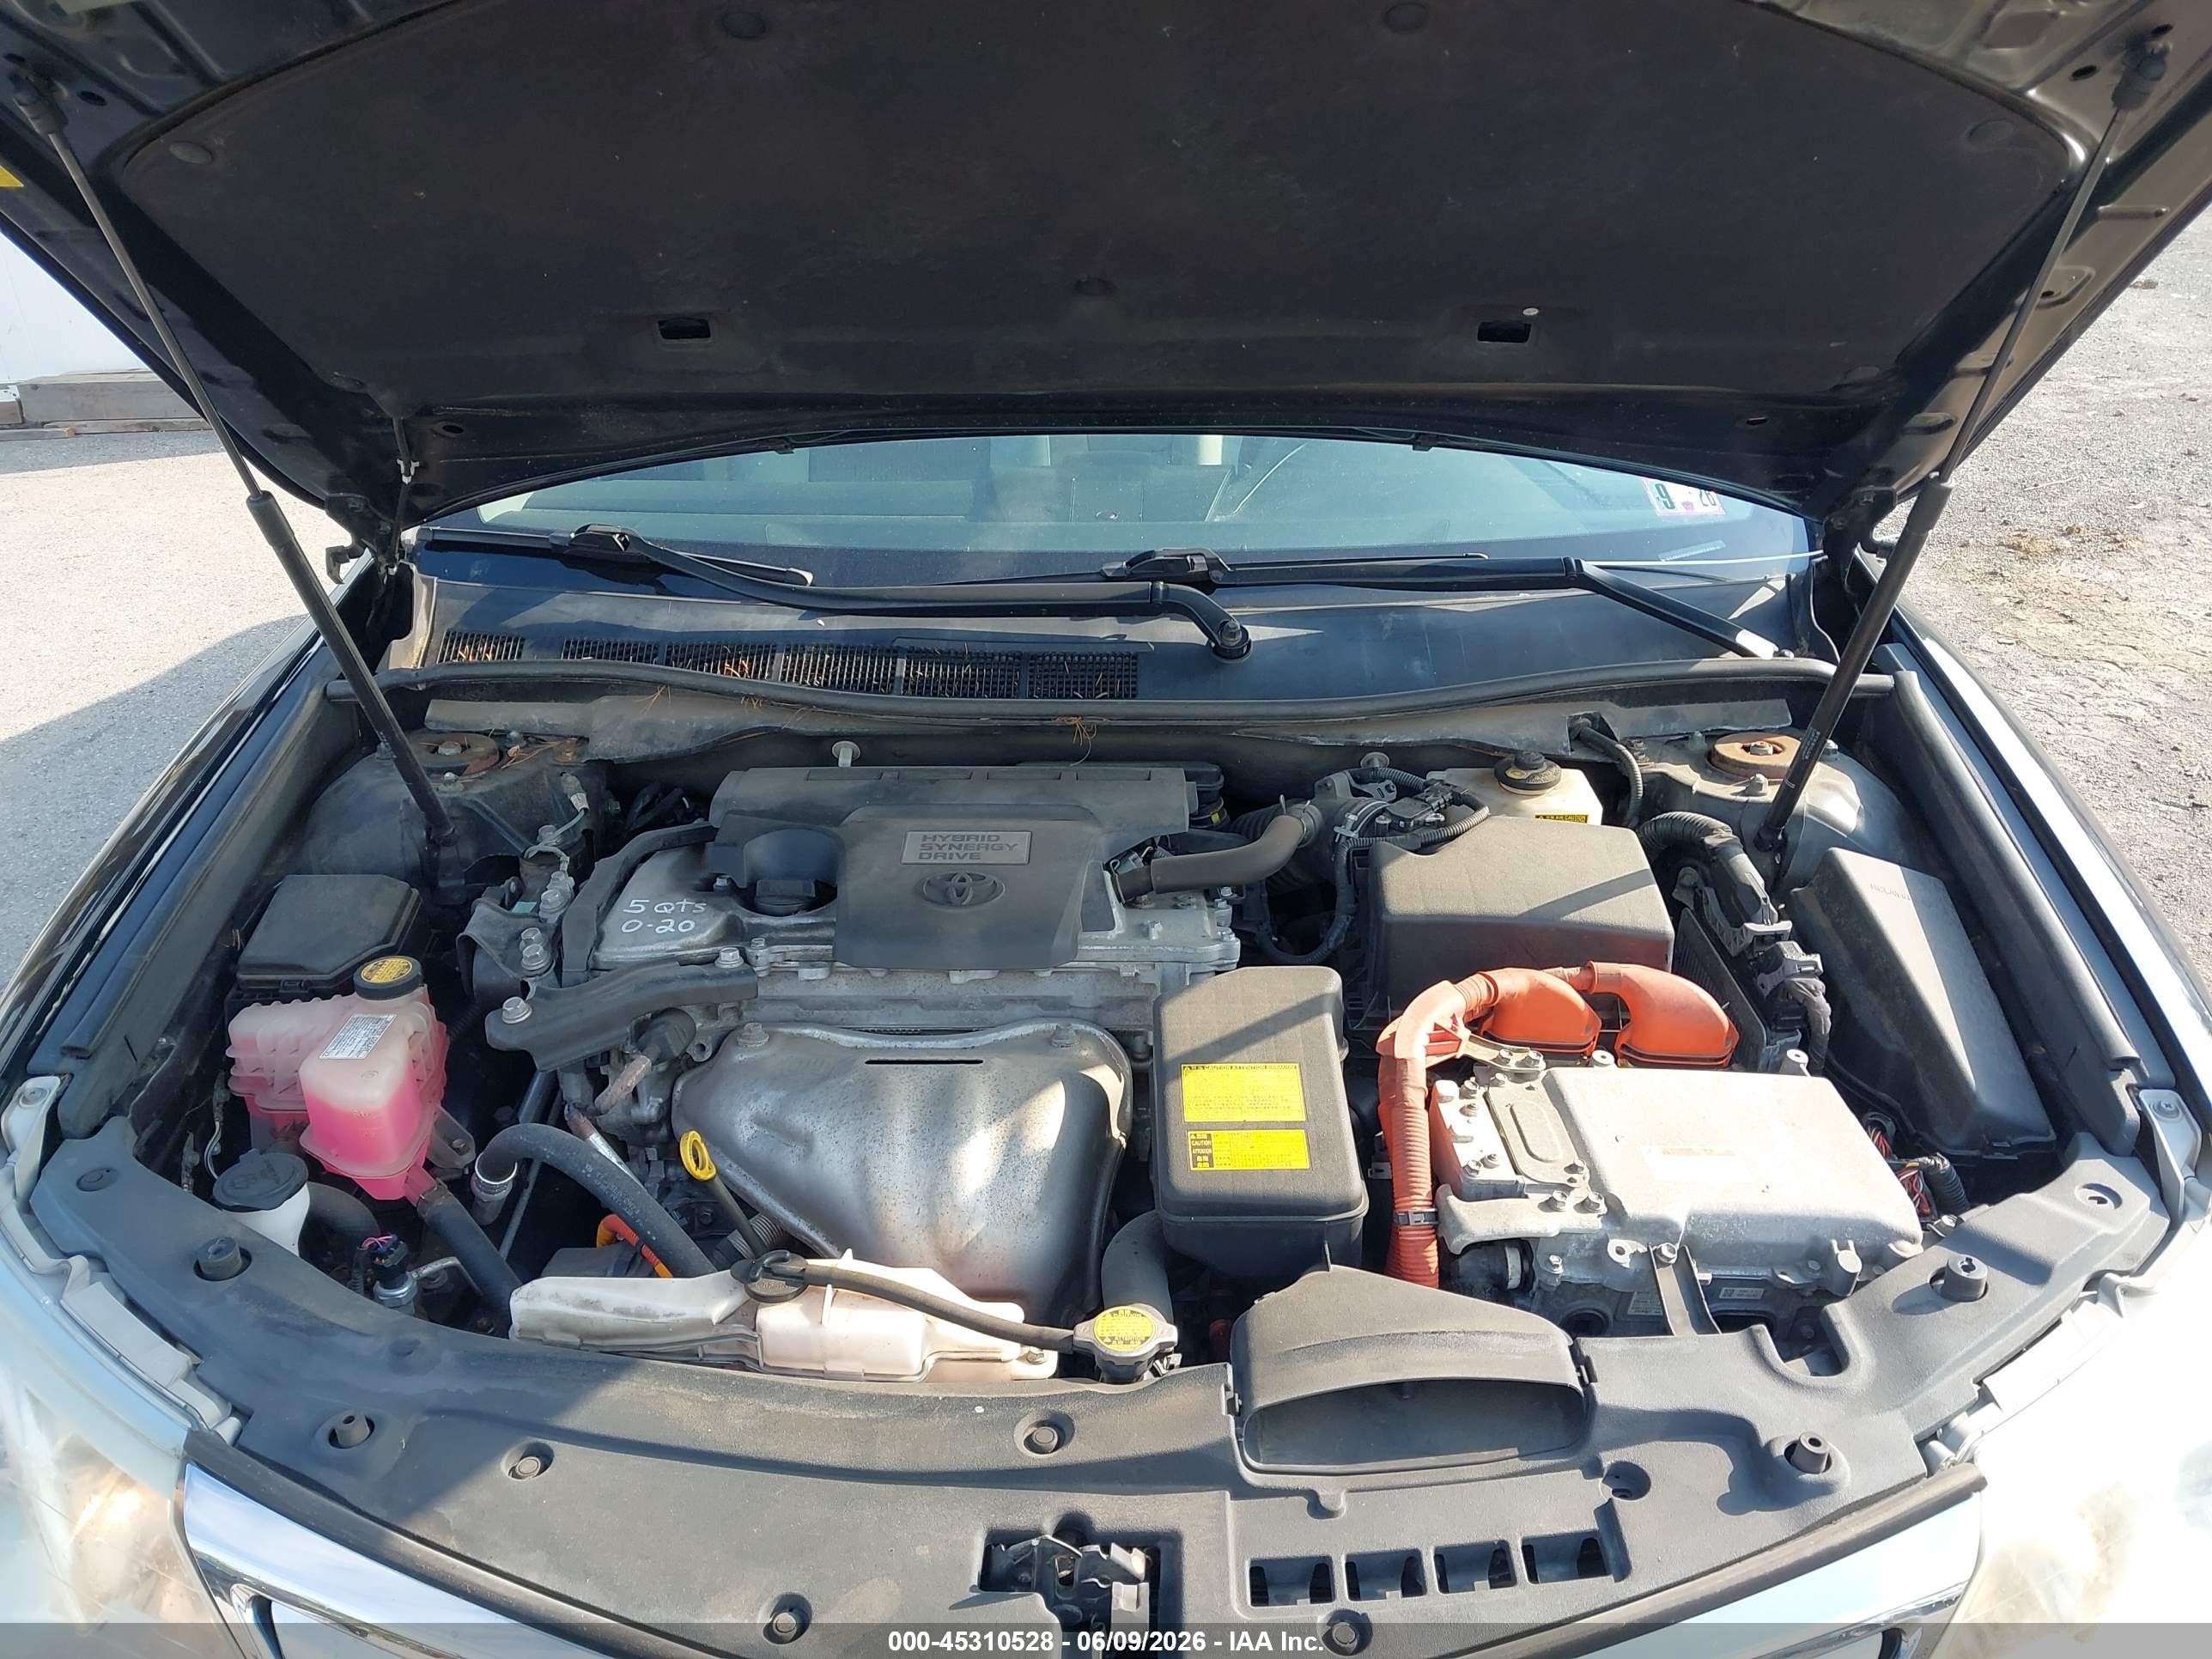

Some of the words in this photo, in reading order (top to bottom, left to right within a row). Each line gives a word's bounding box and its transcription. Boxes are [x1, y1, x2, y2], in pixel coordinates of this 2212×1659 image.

[1655, 483, 1675, 510] 9
[921, 834, 1000, 842] HYBRID
[920, 842, 1018, 851] SYNERGY
[918, 852, 981, 860] DRIVE
[622, 899, 650, 914] 5
[621, 918, 696, 933] 0-20
